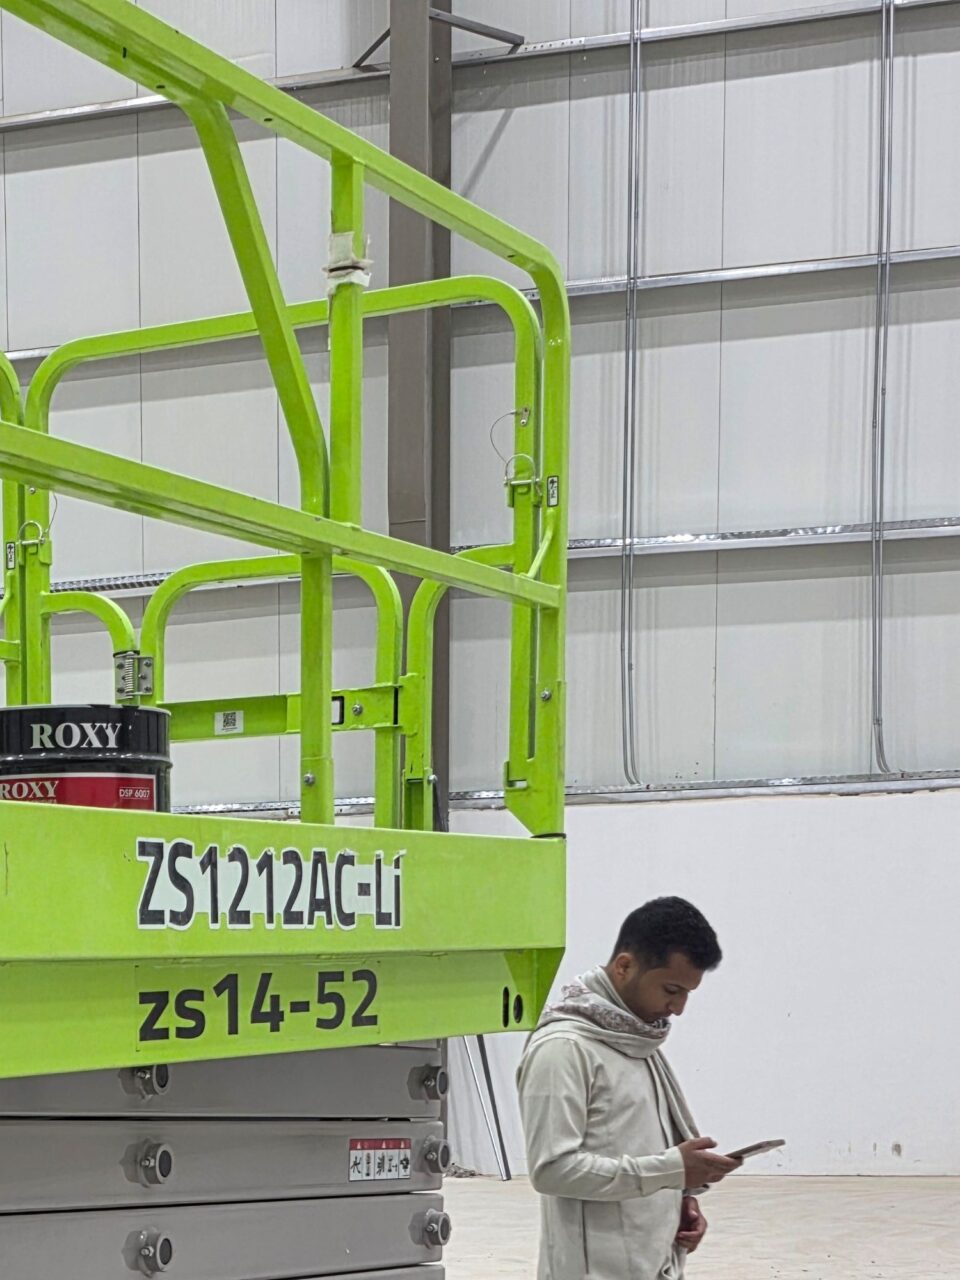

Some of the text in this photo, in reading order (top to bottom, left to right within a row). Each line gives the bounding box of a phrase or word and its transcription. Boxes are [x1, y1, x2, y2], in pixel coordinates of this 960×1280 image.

[30, 722, 122, 749] ROXY
[119, 788, 150, 799] DSP 6007
[137, 839, 404, 928] ZS1212AC-Li
